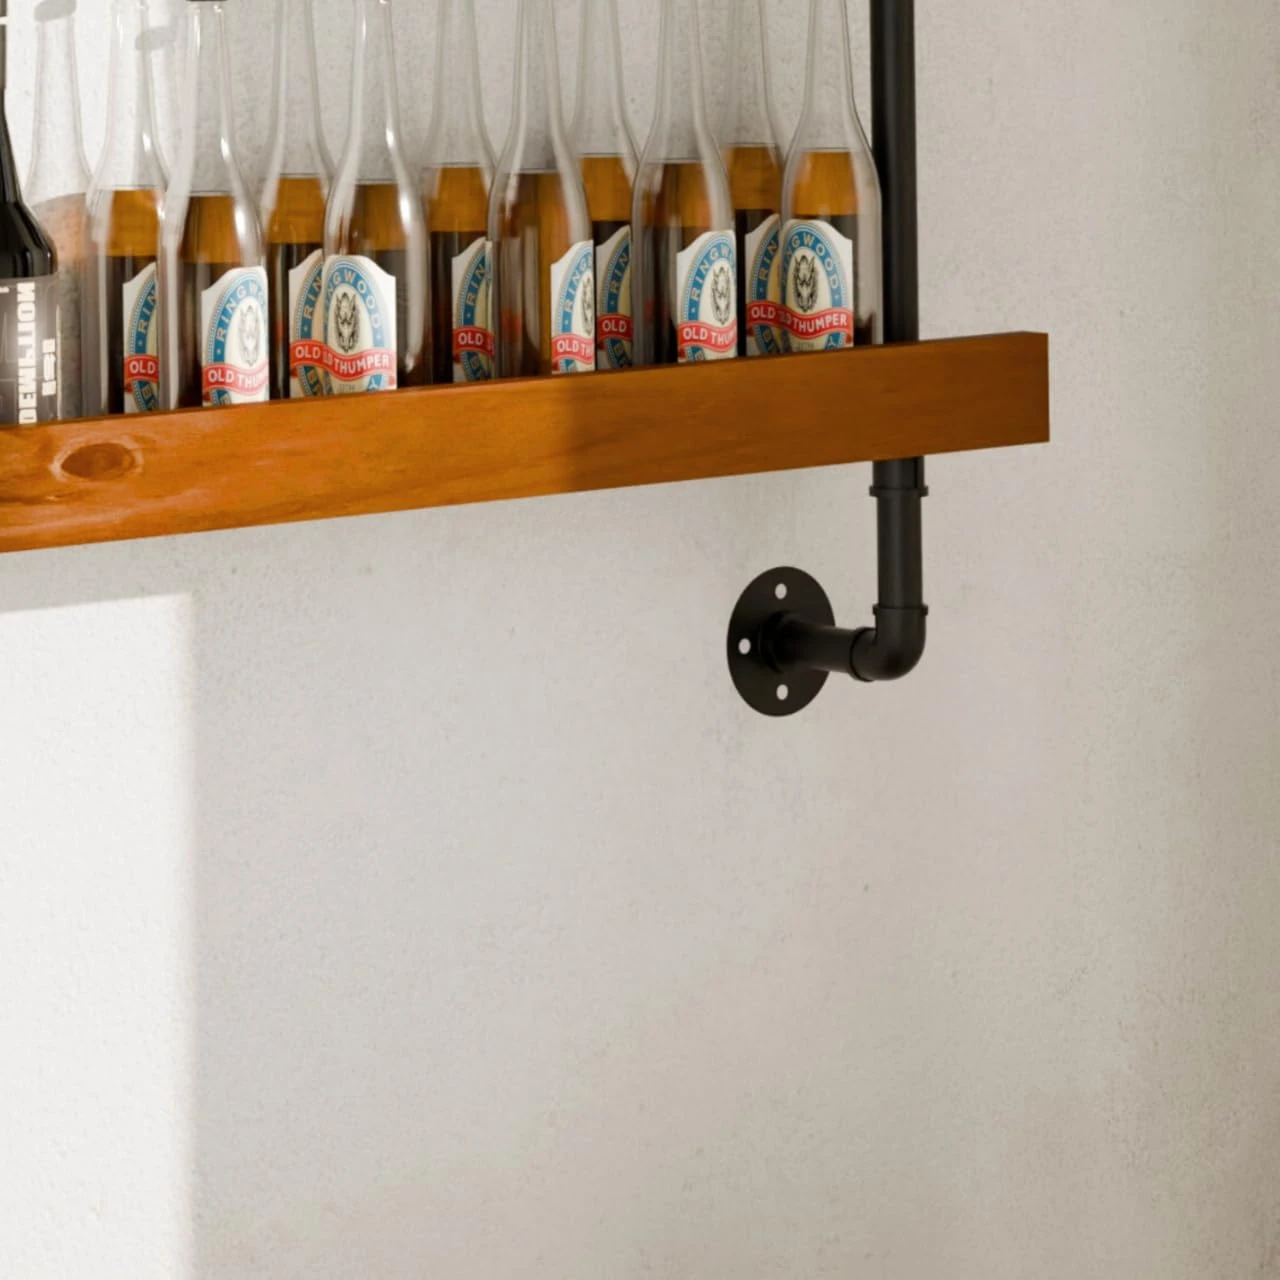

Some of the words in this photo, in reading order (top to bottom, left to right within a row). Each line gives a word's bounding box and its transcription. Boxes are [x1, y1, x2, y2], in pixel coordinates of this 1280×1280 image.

[751, 307, 776, 319] OLD
[602, 320, 627, 333] OLD
[792, 313, 848, 333] THUMPER
[458, 333, 484, 346] OLD
[683, 328, 708, 340] OLD
[295, 346, 321, 359] OLD
[556, 339, 578, 353] OLD
[129, 361, 156, 374] OLD
[334, 354, 390, 375] THUMPER
[208, 370, 234, 383] OLD
